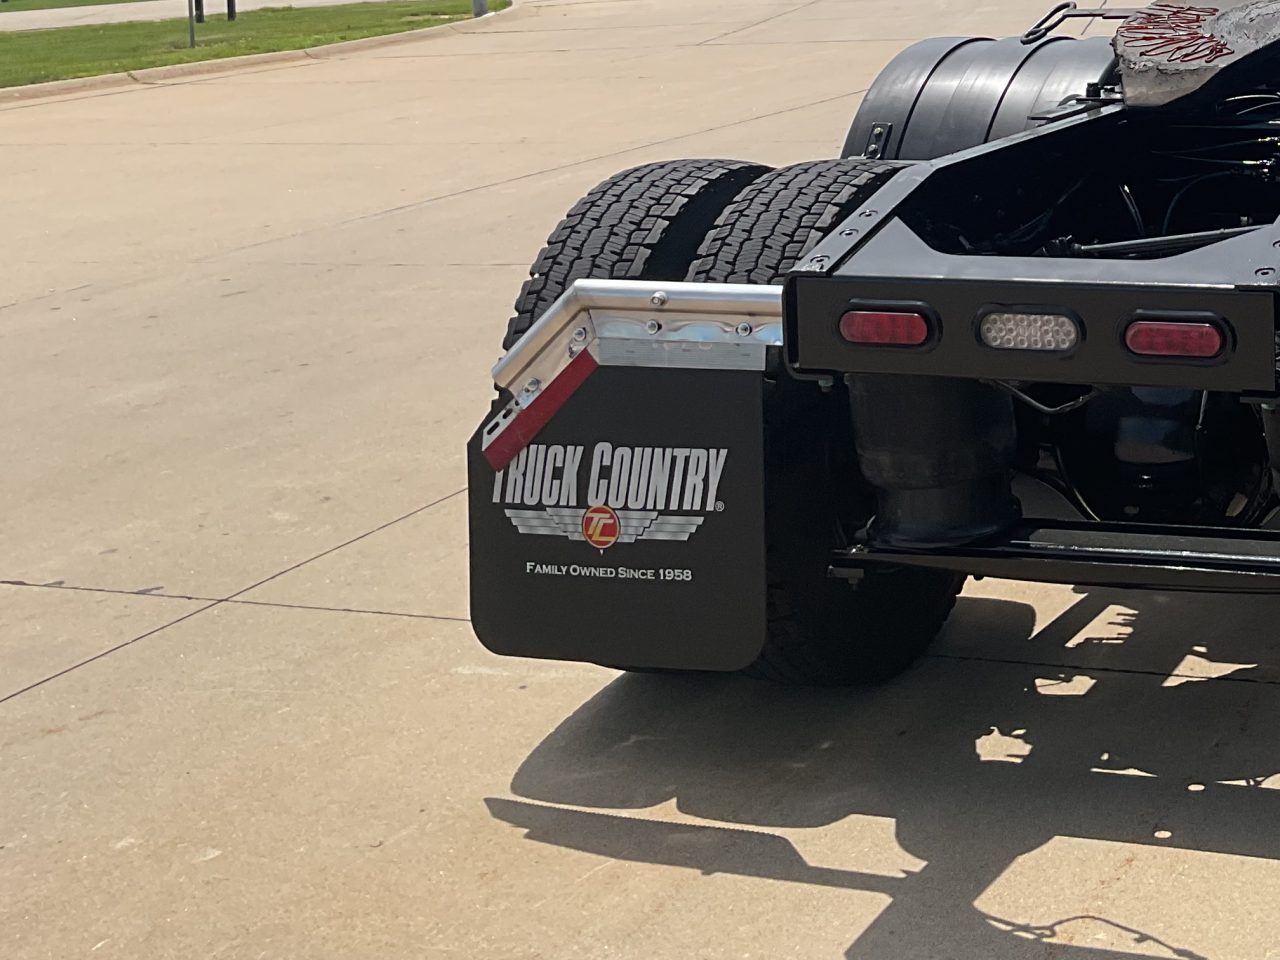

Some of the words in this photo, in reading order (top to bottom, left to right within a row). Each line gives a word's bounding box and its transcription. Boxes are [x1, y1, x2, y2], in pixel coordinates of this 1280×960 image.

[587, 441, 729, 512] COUNTRY
[526, 562, 567, 576] FAMILY
[569, 565, 616, 578] OWNED
[618, 567, 655, 580] SINCE
[658, 569, 693, 581] 1958
